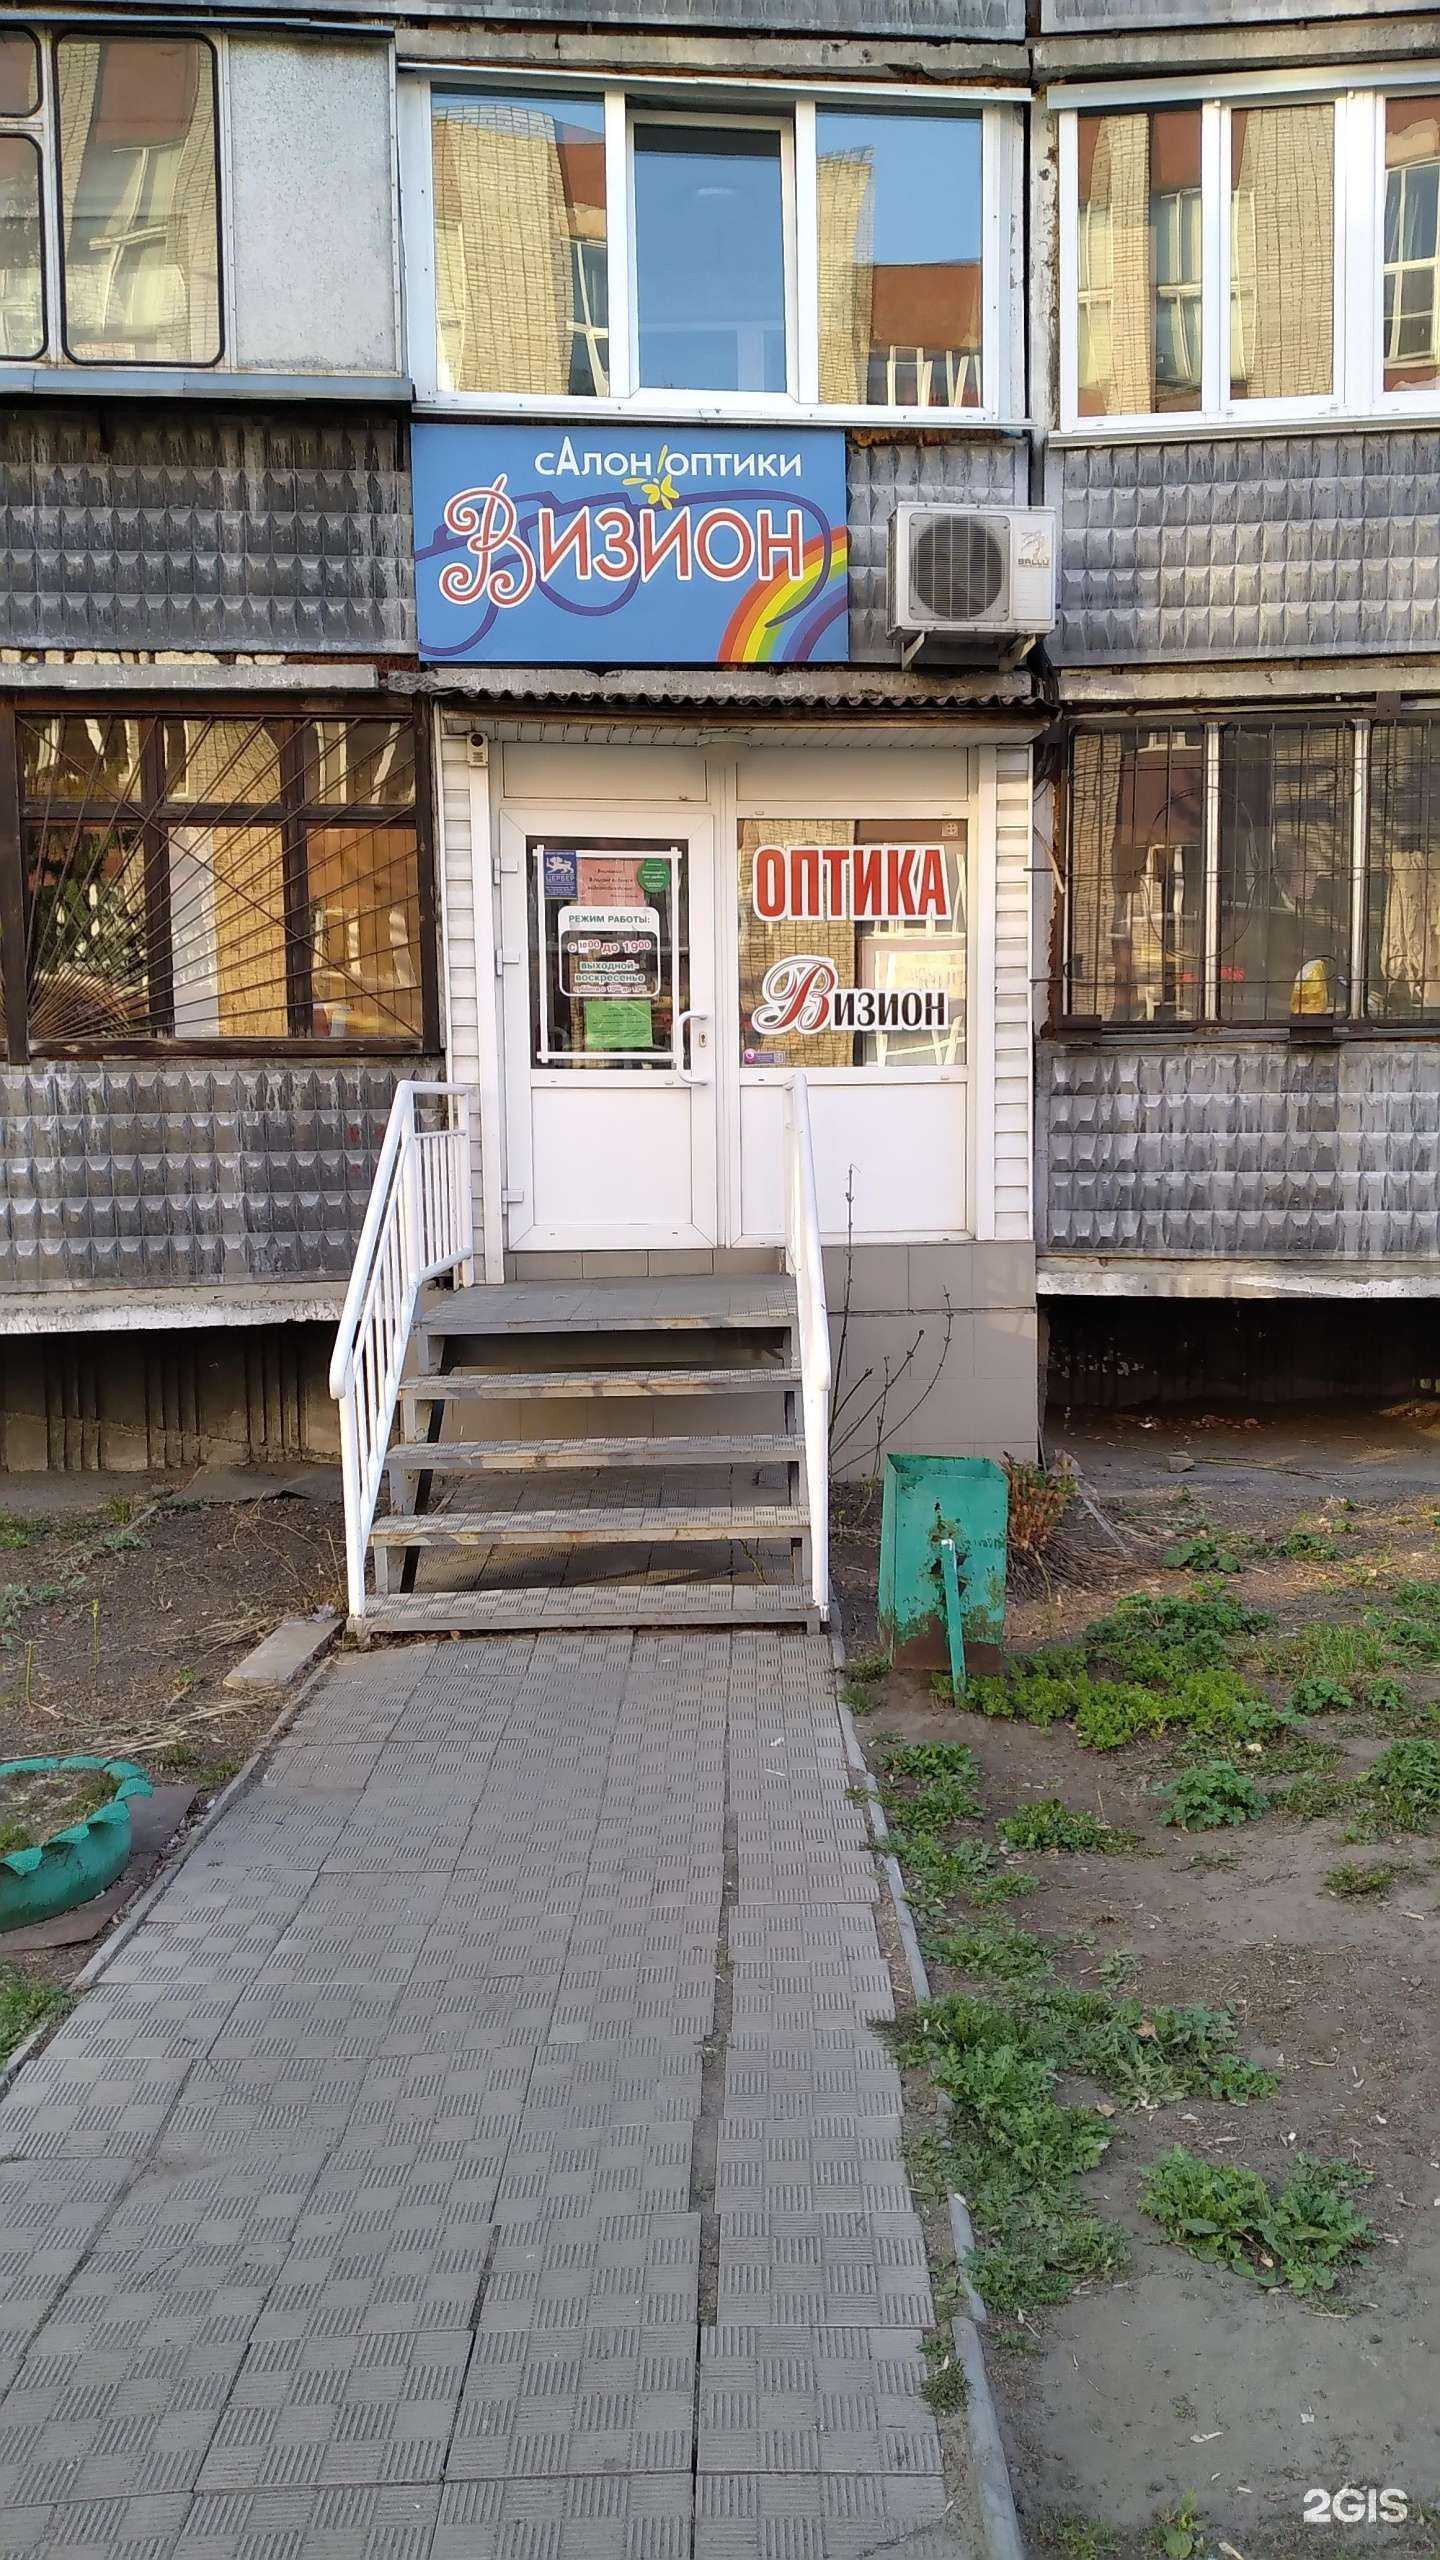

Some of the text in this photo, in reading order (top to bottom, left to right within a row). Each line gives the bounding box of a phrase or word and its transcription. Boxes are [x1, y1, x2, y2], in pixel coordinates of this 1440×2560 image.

[439, 473, 805, 608] Визион
[754, 846, 950, 919] ОПТИКА
[568, 915, 651, 924] РЕЖИМ РАБОТЫ:
[602, 944, 619, 954] до
[575, 974, 645, 984] воскресенье
[754, 957, 948, 1032] Визион
